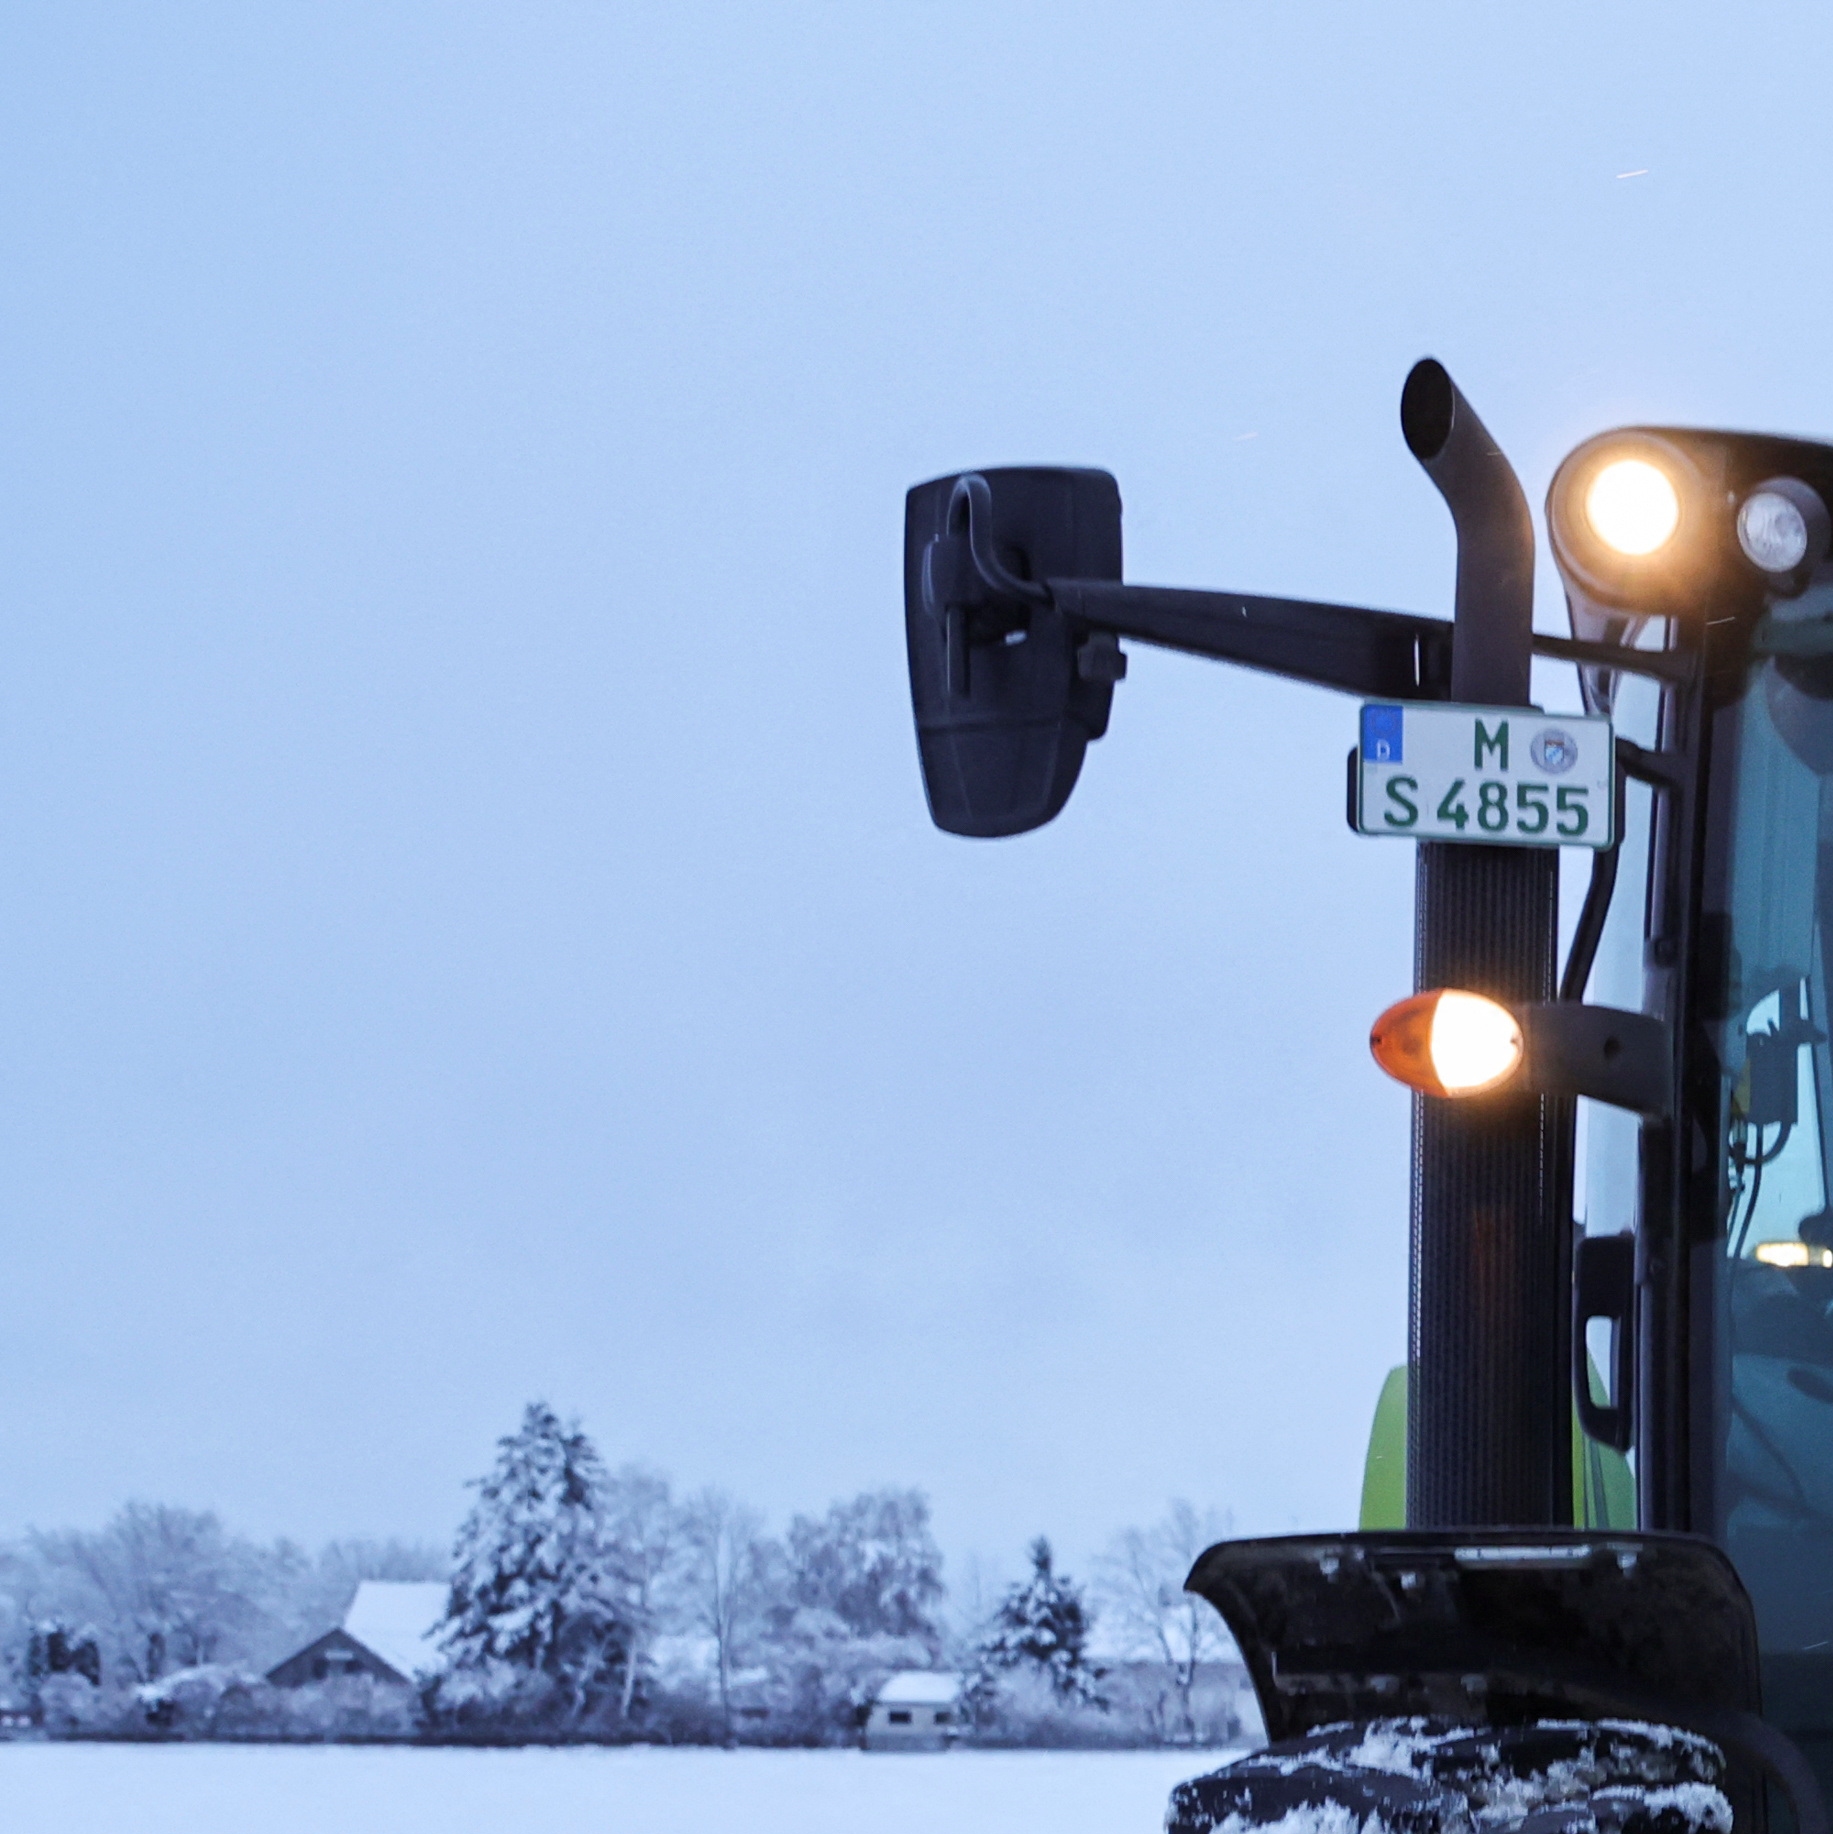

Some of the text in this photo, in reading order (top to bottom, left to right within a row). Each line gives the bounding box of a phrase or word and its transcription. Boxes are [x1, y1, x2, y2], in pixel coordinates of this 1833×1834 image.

[1473, 718, 1510, 772] M
[1383, 776, 1590, 837] S 4855
